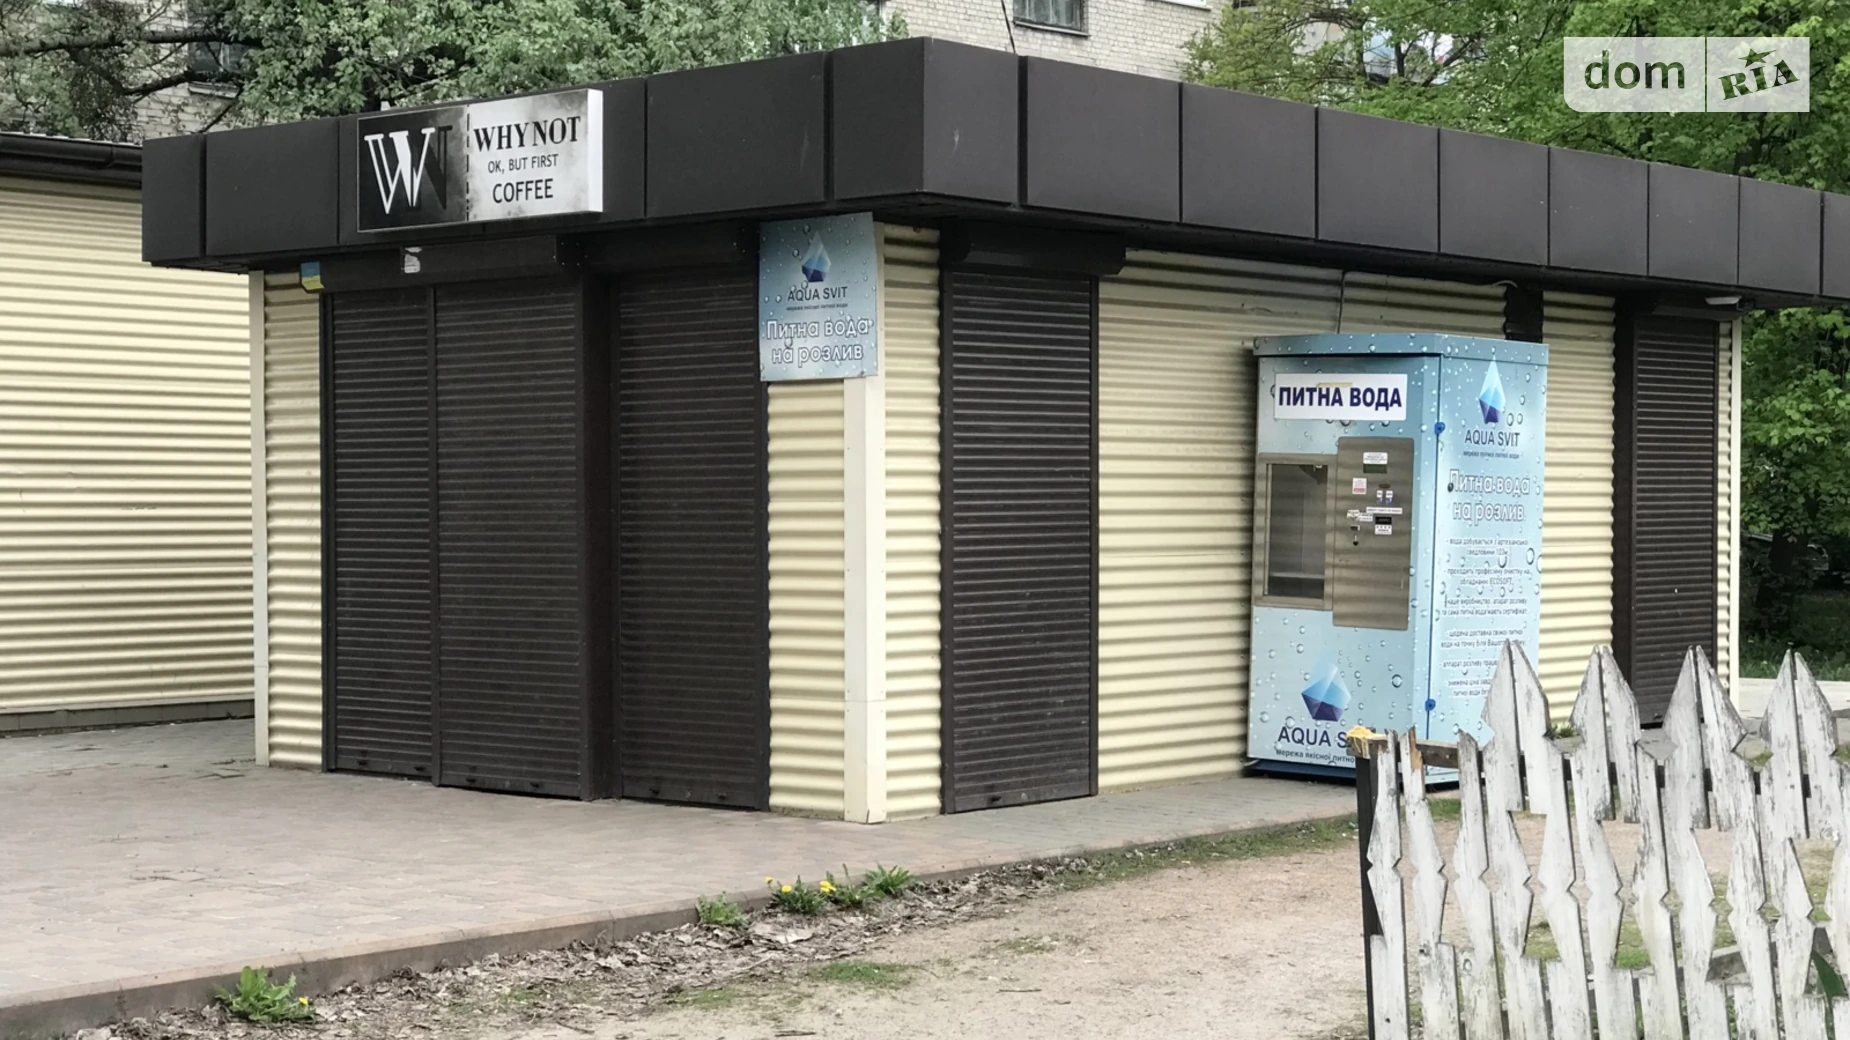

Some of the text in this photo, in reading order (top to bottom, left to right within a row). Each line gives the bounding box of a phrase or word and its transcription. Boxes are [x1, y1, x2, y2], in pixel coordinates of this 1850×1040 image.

[487, 154, 559, 175] OK, BUT FIRST
[492, 178, 554, 203] COFFEE
[787, 286, 848, 301] AQUA SVIT
[766, 318, 869, 340] Питна вода
[772, 345, 864, 368] на розлив
[1278, 386, 1402, 411] ПИТНА ВОДА
[1464, 429, 1520, 447] AQUA SVIT
[1449, 469, 1530, 497] Питна вода
[1452, 502, 1525, 526] на розлив
[1277, 726, 1331, 747] AQUA
[1332, 755, 1355, 763] питно
